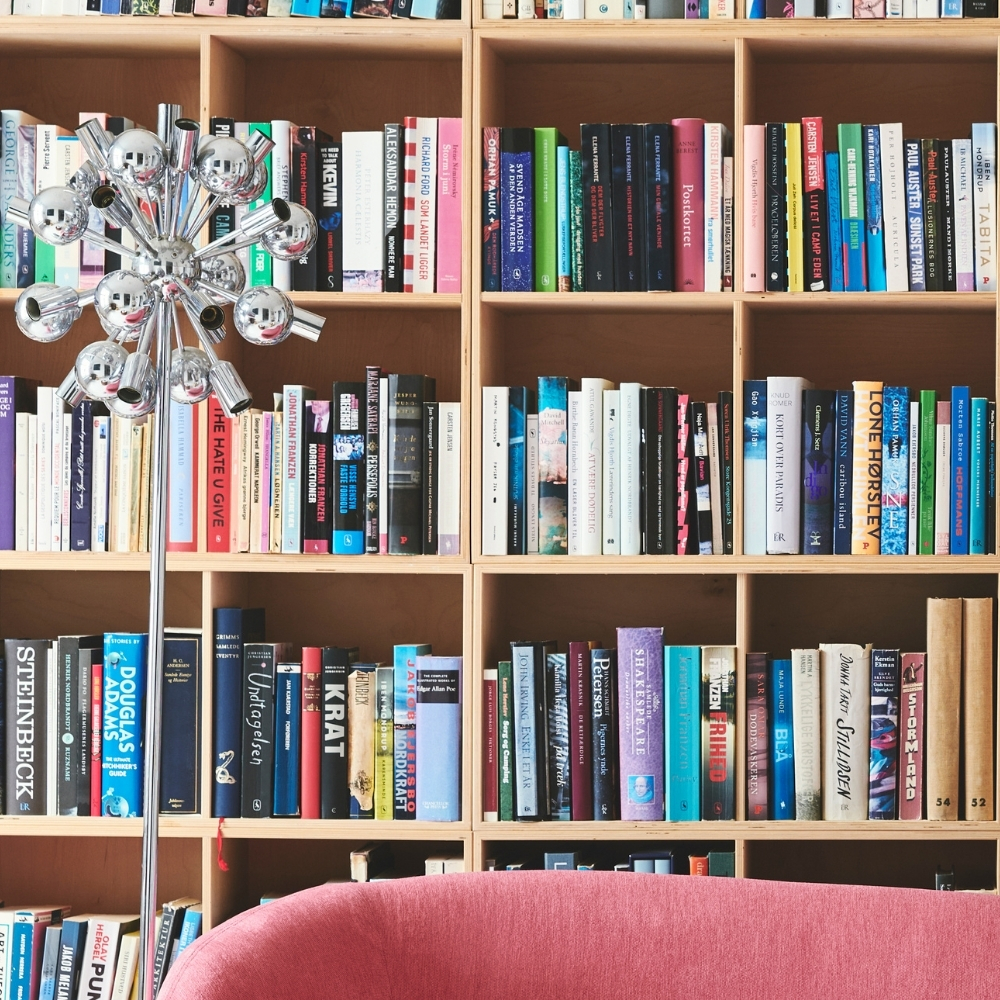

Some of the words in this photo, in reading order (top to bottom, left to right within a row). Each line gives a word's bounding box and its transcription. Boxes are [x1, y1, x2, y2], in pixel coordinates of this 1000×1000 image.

[5, 120, 16, 175] GEORGE
[421, 137, 431, 172] RICHARD
[710, 125, 718, 166] KIRSTEN
[806, 121, 817, 153] CARSTEN
[387, 127, 397, 192] ALEKSANDAR
[442, 144, 451, 171] Storm
[488, 138, 497, 176] ORHAN
[807, 155, 818, 187] JENSEN
[907, 143, 919, 168] PAUL
[323, 164, 337, 207] KEVIN
[421, 174, 431, 196] FORD
[440, 177, 451, 195] juni
[488, 179, 497, 215] PAMUK
[710, 168, 718, 220] HAMMANN
[908, 170, 922, 209] AUSTER
[387, 196, 397, 228] HEMON
[420, 200, 430, 217] SOM
[517, 195, 525, 212] ÅGE
[683, 184, 694, 247] Postkortet
[810, 194, 819, 221] LIVET
[420, 219, 429, 250] LANDET
[811, 232, 821, 255] CAMP
[910, 217, 922, 255] SUNSET
[979, 203, 991, 267] TABITA
[419, 252, 428, 280] LIGGER
[813, 257, 822, 278] EDEN
[911, 258, 923, 284] PARK
[367, 370, 378, 403] MARJANE
[213, 407, 225, 433] THE
[367, 405, 378, 434] SATRAPI
[775, 413, 784, 439] KORT
[840, 395, 848, 426] DAVID
[869, 391, 881, 442] LONE
[213, 438, 225, 474] HATE
[308, 443, 317, 503] KORREKTIONER
[317, 443, 326, 484] JONATHAN
[775, 442, 784, 469] OVER
[213, 479, 224, 488] U
[367, 454, 378, 498] PERSEPOLIS
[775, 471, 784, 512] PARADIS
[839, 464, 847, 499] caribou
[213, 493, 224, 527] GIVE
[317, 487, 325, 522] FRANZEN
[867, 449, 881, 539] HØRSLEV
[955, 466, 963, 536] HOFFMANS
[838, 502, 847, 529] island
[839, 653, 853, 686] DONNA
[407, 659, 415, 721] JAKOB
[592, 657, 611, 718] Petersen
[635, 649, 645, 755] SHAKESPEARE
[840, 688, 852, 716] TARTT
[15, 646, 35, 800] STEINBECK
[104, 677, 119, 741] ADAMS
[118, 666, 136, 753] DOUGLAS
[245, 672, 272, 765] Undtagelsen
[324, 683, 345, 758] KRAT
[709, 712, 727, 782] FRIHED
[750, 714, 758, 795] DØDEVASKEREN
[775, 728, 792, 763] BLÅ
[836, 718, 855, 800] STILLIDSEN
[395, 729, 407, 812] NORDKRAFT
[407, 730, 416, 813] EJERSBO
[936, 798, 951, 807] 54
[971, 798, 986, 807] 52
[60, 944, 74, 972] JAKOB
[92, 924, 104, 961] HERGEL
[99, 935, 110, 962] OLAV
